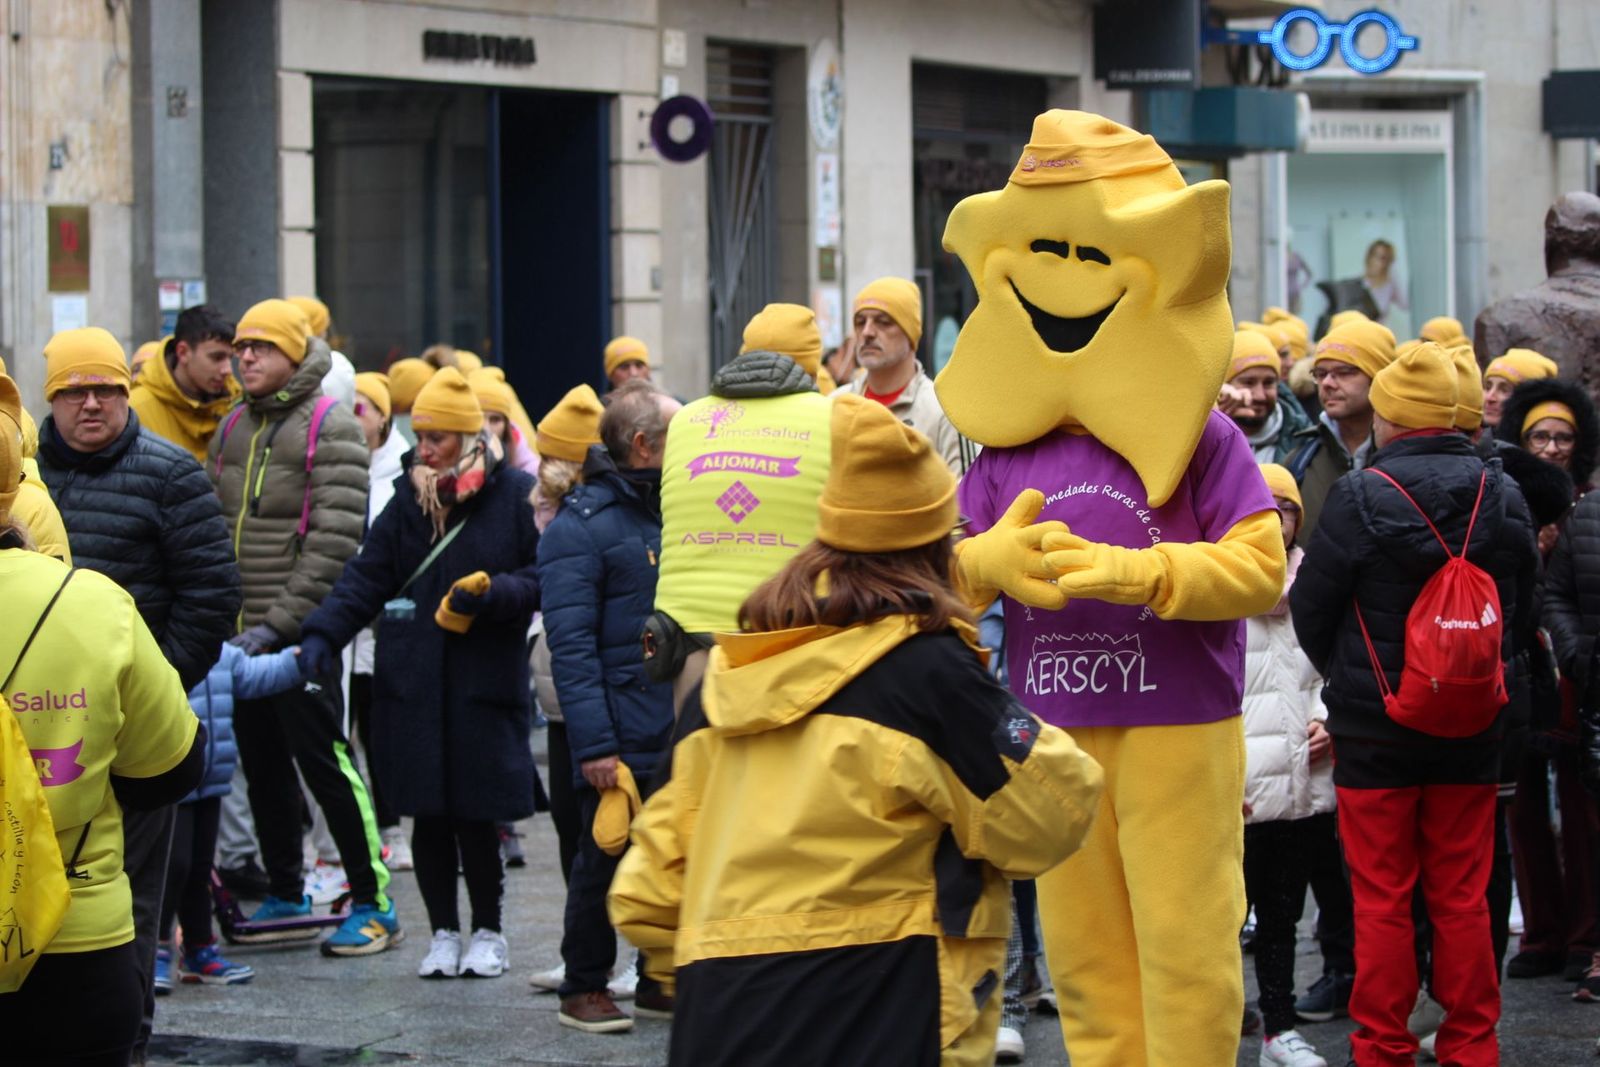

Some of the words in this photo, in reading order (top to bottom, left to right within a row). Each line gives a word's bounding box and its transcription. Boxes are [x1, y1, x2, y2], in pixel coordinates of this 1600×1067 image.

[702, 455, 780, 474] ALJOMAR
[1041, 482, 1100, 510] medades
[1101, 484, 1138, 510] Raras
[1135, 508, 1151, 525] de
[681, 531, 800, 548] ASPREL
[1024, 653, 1158, 696] AERSCYL
[7, 687, 88, 713] Salud
